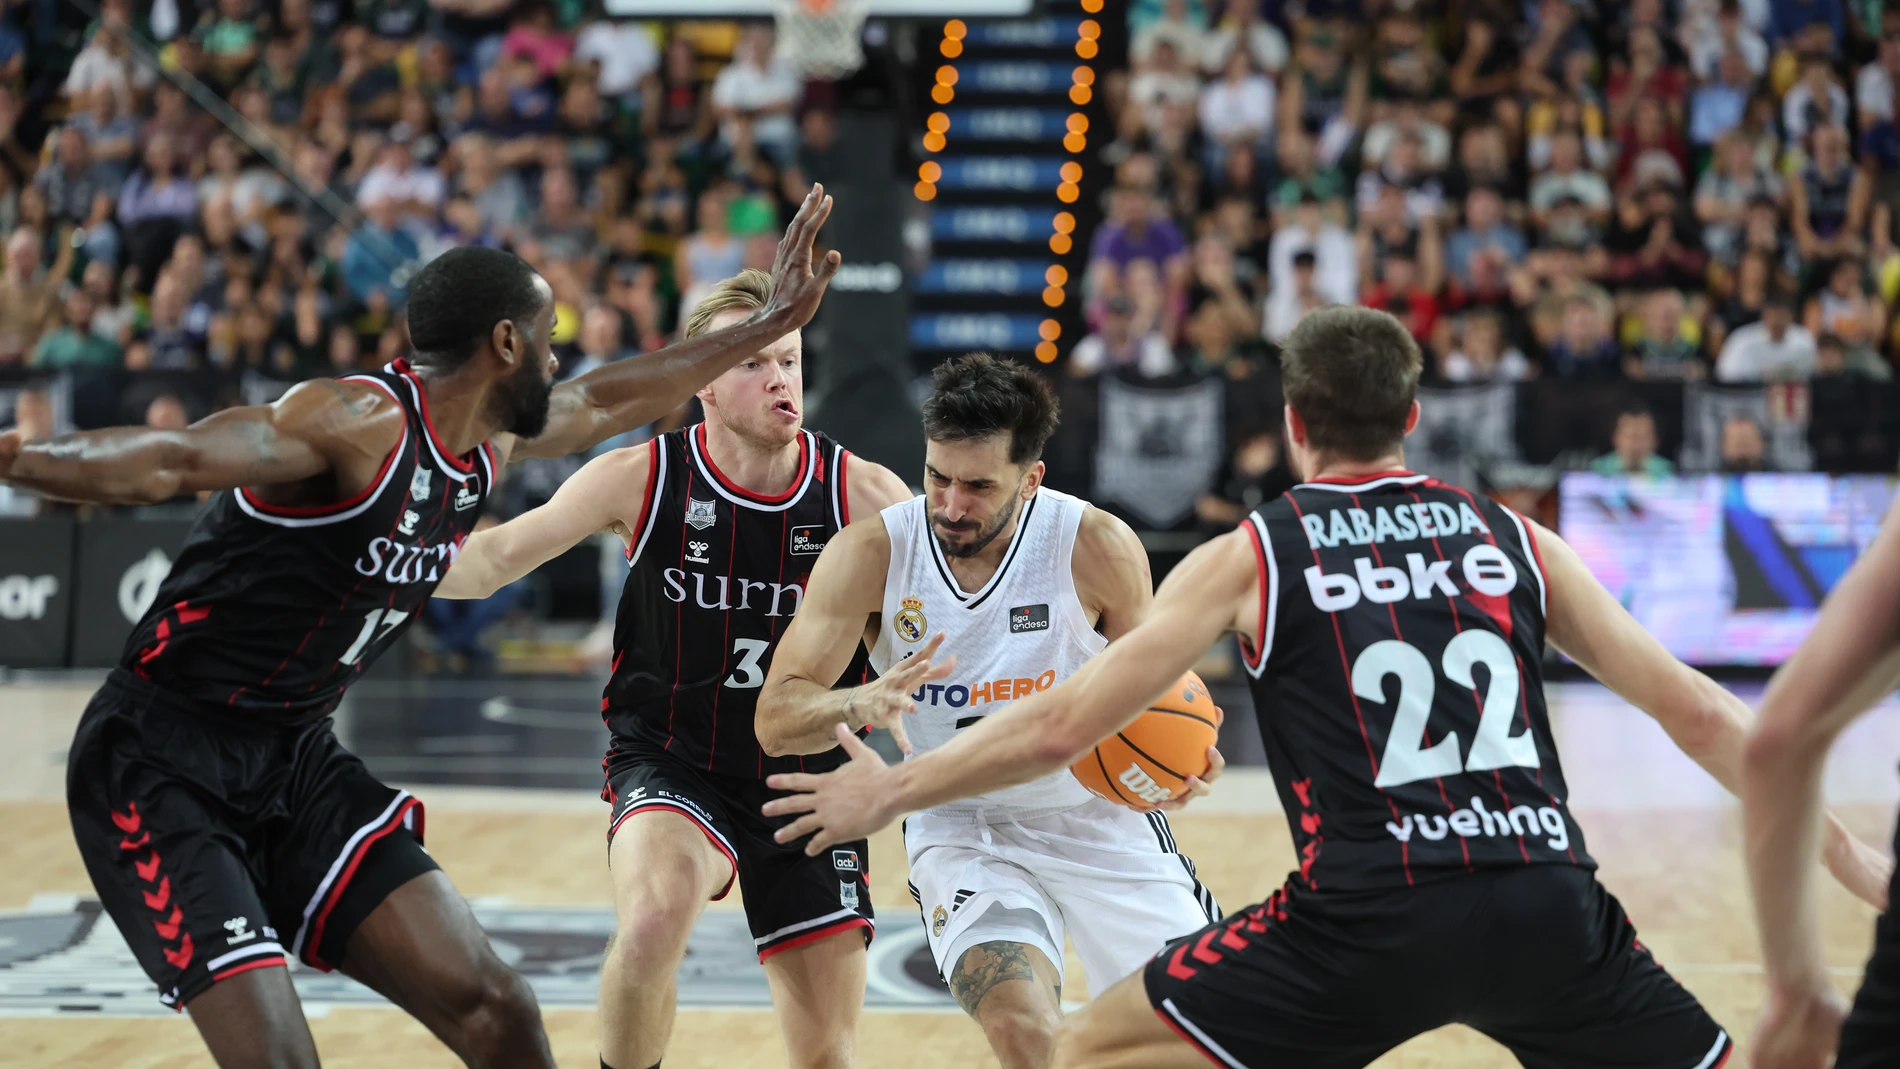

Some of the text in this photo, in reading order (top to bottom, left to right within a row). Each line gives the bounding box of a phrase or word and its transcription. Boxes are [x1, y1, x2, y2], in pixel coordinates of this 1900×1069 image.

[794, 535, 808, 544] liga
[1301, 502, 1489, 549] RABASEDA
[355, 534, 468, 584] surn
[1304, 553, 1460, 612] bbk
[663, 567, 805, 617] surn
[338, 608, 410, 665] 17
[1012, 615, 1029, 623] liga
[1012, 620, 1047, 630] endesa
[723, 638, 770, 689] 3
[911, 669, 1056, 708] UTOHERO
[1351, 628, 1541, 788] 22
[658, 790, 674, 798] EL
[1386, 796, 1569, 851] vueling
[836, 858, 854, 868] acb
